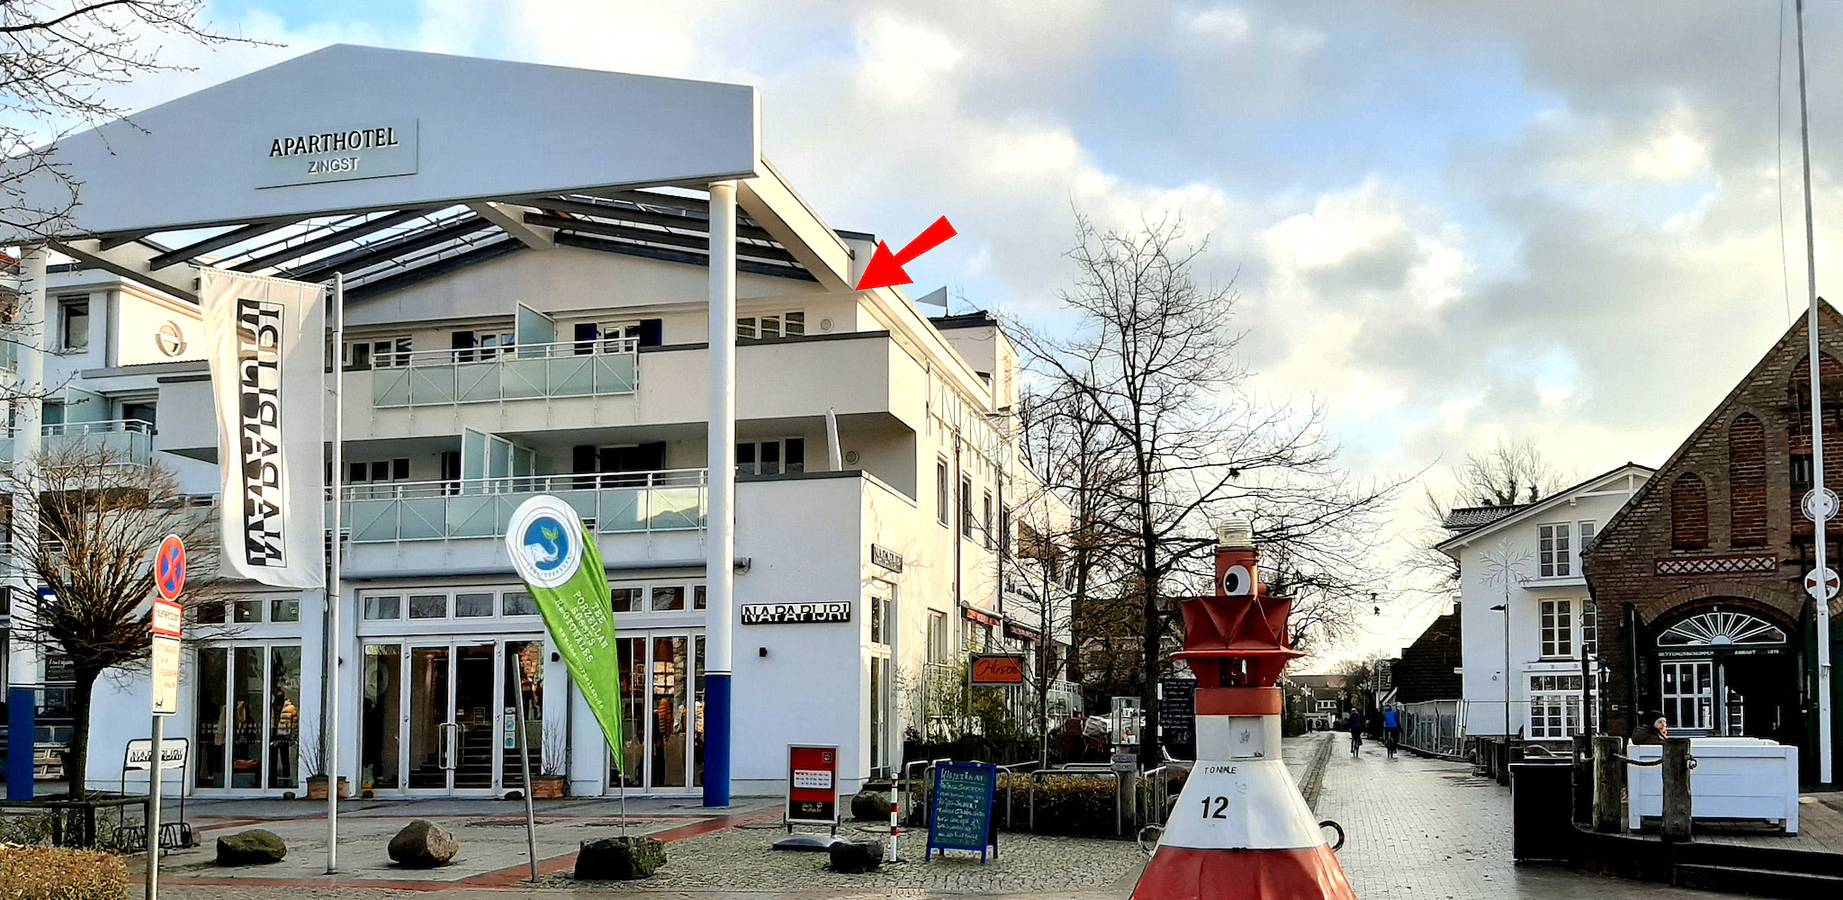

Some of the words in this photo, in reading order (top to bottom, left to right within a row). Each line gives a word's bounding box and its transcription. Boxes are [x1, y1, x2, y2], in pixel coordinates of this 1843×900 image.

[269, 127, 399, 157] APARTHOTEL
[308, 156, 358, 173] ZINGST
[573, 590, 609, 649] PORZELLAN
[592, 601, 607, 625] TEE
[743, 603, 849, 623] NAPAPIJRI
[555, 598, 594, 663] REGIONALES
[1201, 796, 1229, 819] 12
